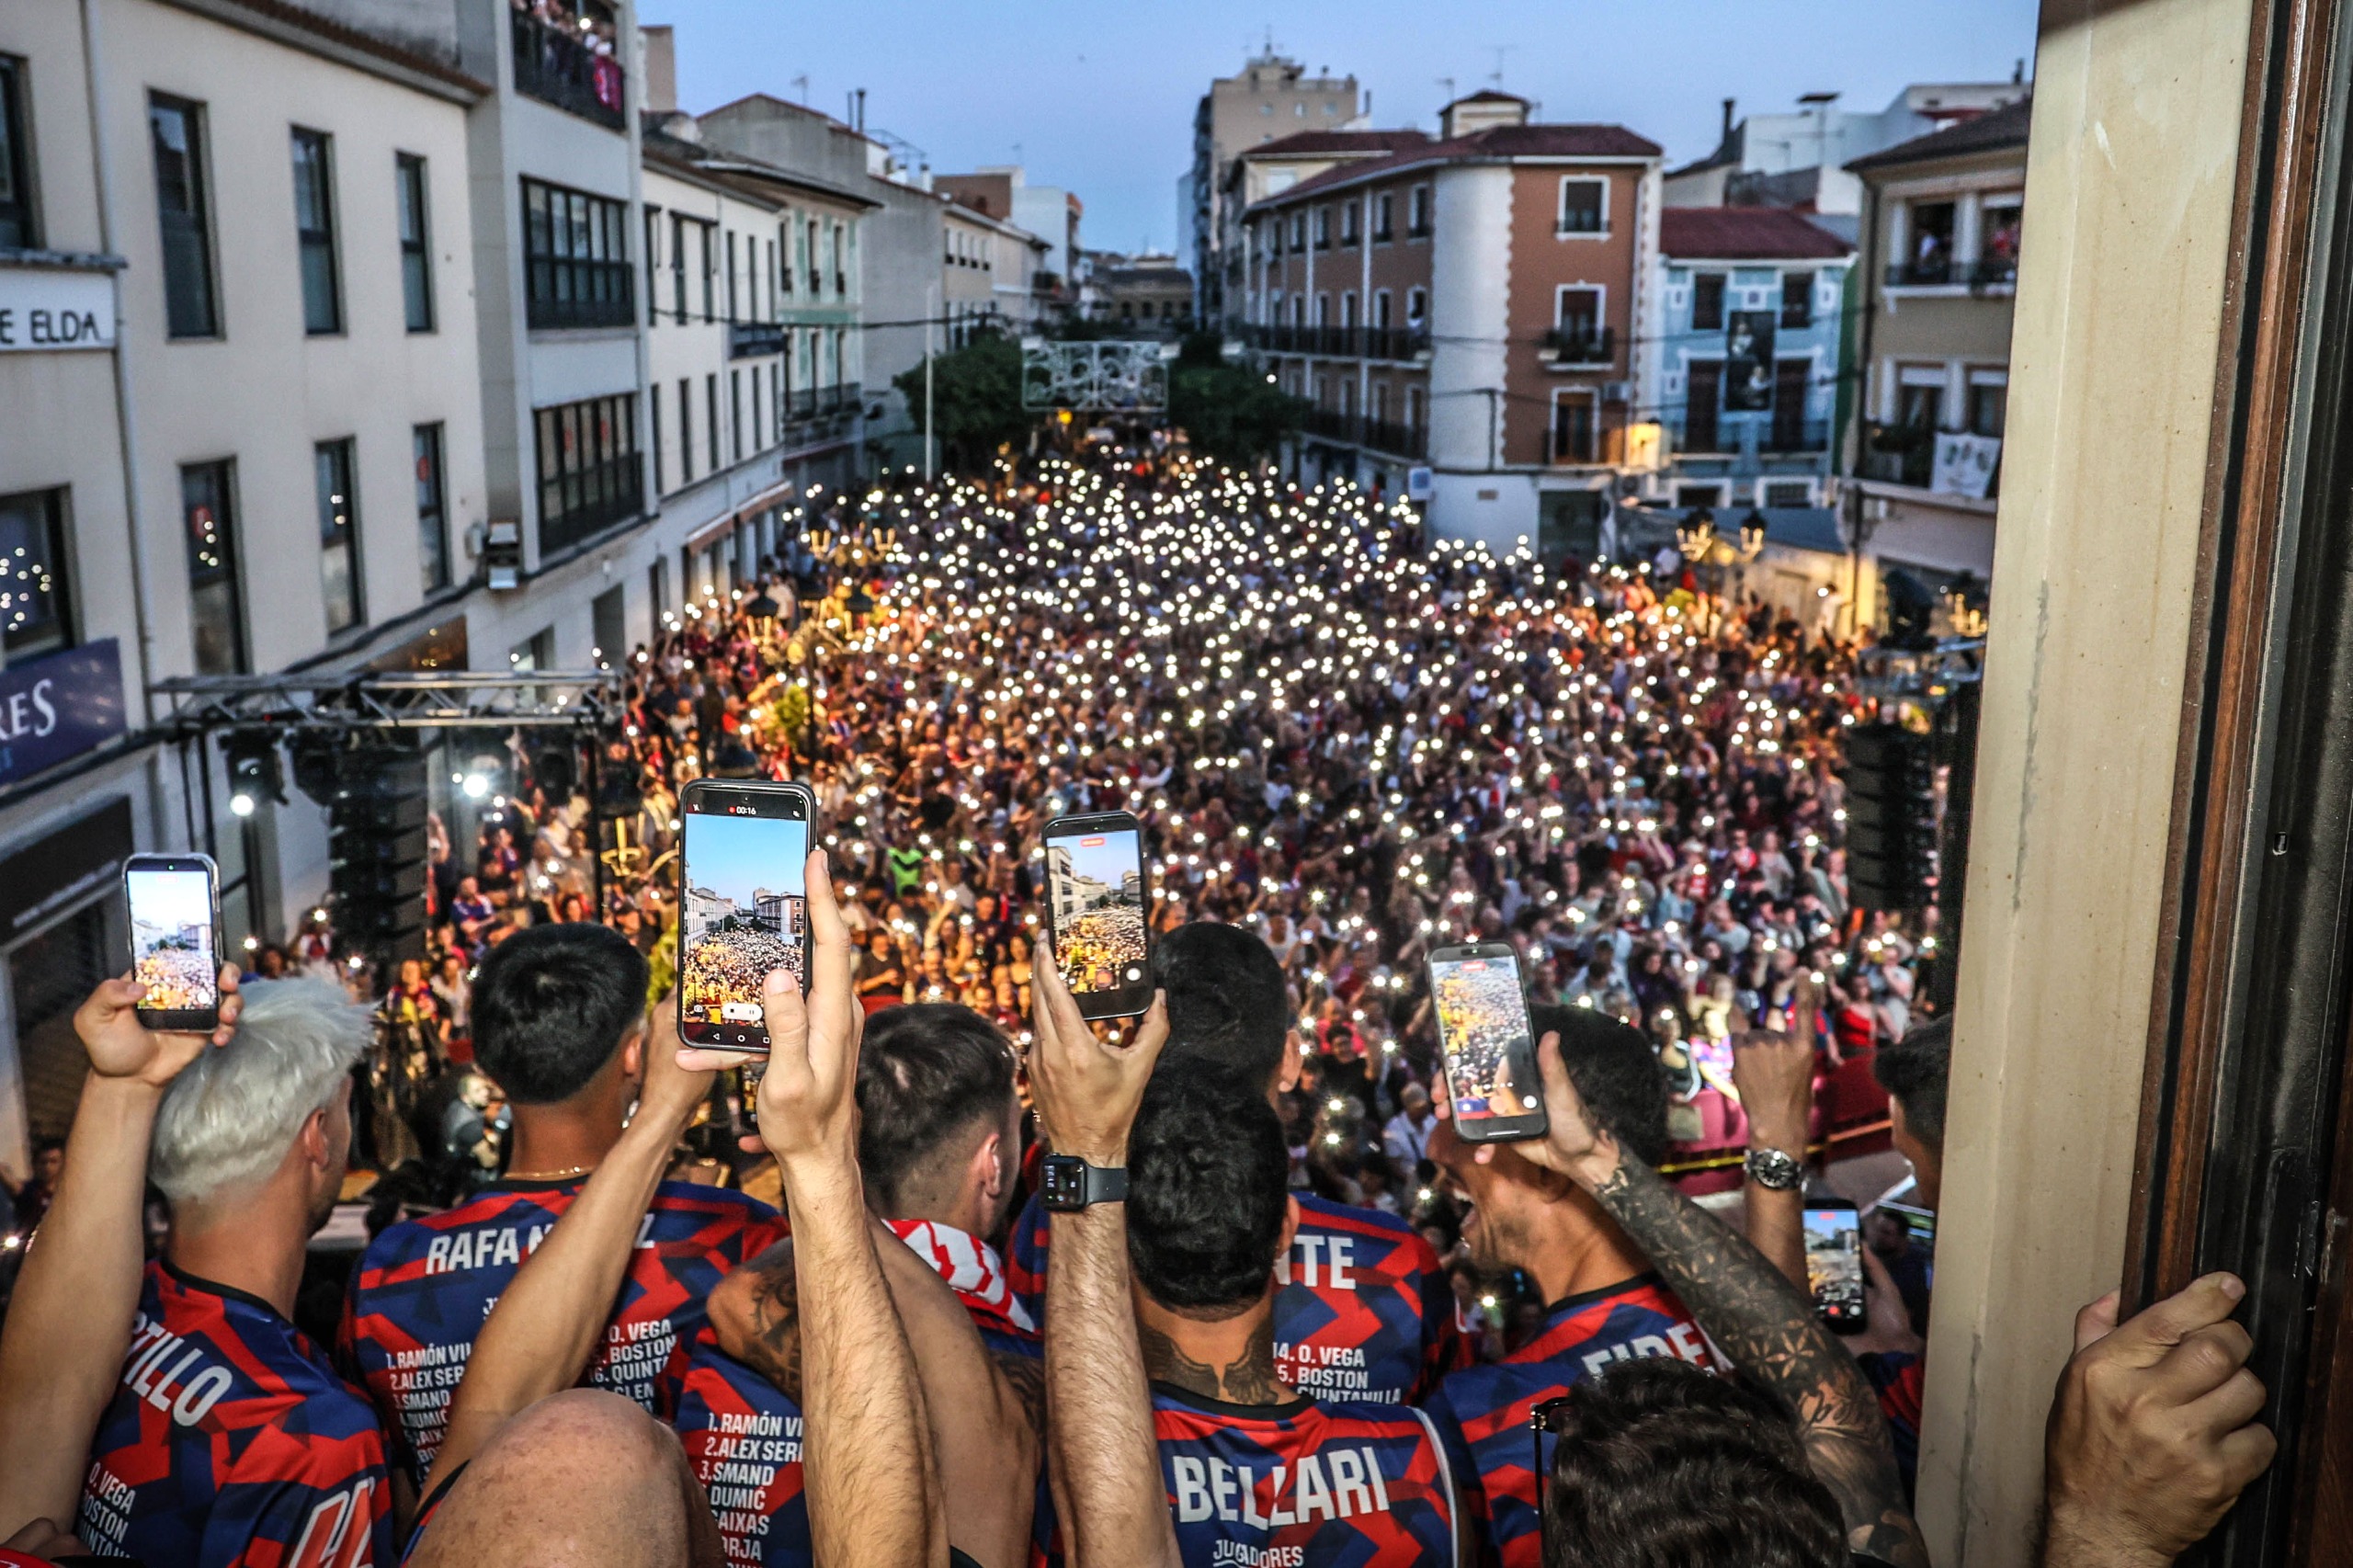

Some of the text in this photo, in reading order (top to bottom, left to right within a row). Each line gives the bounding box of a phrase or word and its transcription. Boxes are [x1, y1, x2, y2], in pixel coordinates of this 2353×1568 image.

[30, 310, 100, 344] ELDA
[736, 805, 756, 815] 00:16
[426, 1228, 519, 1275] RAFA
[628, 1318, 672, 1341] VEGA
[397, 1343, 447, 1369] RAMÓN
[609, 1335, 676, 1364] BOSTON
[1319, 1346, 1365, 1368] VEGA
[1274, 1364, 1369, 1390] 5. BOSTON
[721, 1410, 781, 1437] RAMÓN
[98, 1471, 137, 1515] VEGA
[710, 1486, 766, 1510] DUMIĆ
[1173, 1446, 1390, 1530] BELLARI
[84, 1489, 129, 1544] OSTON
[1212, 1540, 1304, 1568] JUGADORES
